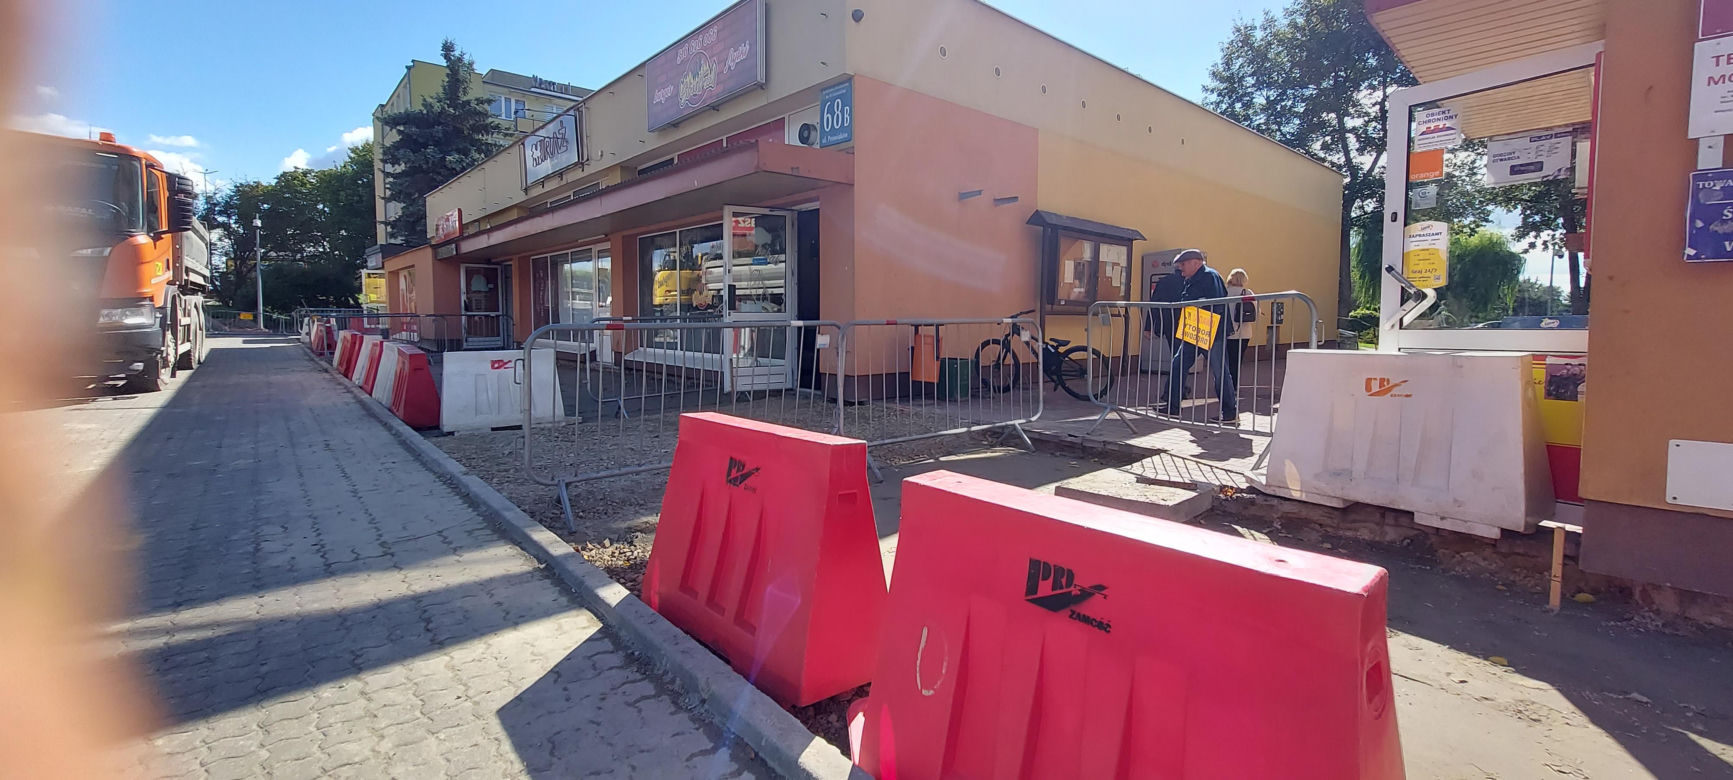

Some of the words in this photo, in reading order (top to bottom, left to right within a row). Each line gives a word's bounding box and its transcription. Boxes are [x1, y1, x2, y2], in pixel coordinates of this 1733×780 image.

[1425, 109, 1452, 118] OBIEKT
[1417, 114, 1459, 125] CHRONIONY
[1411, 170, 1440, 180] orange
